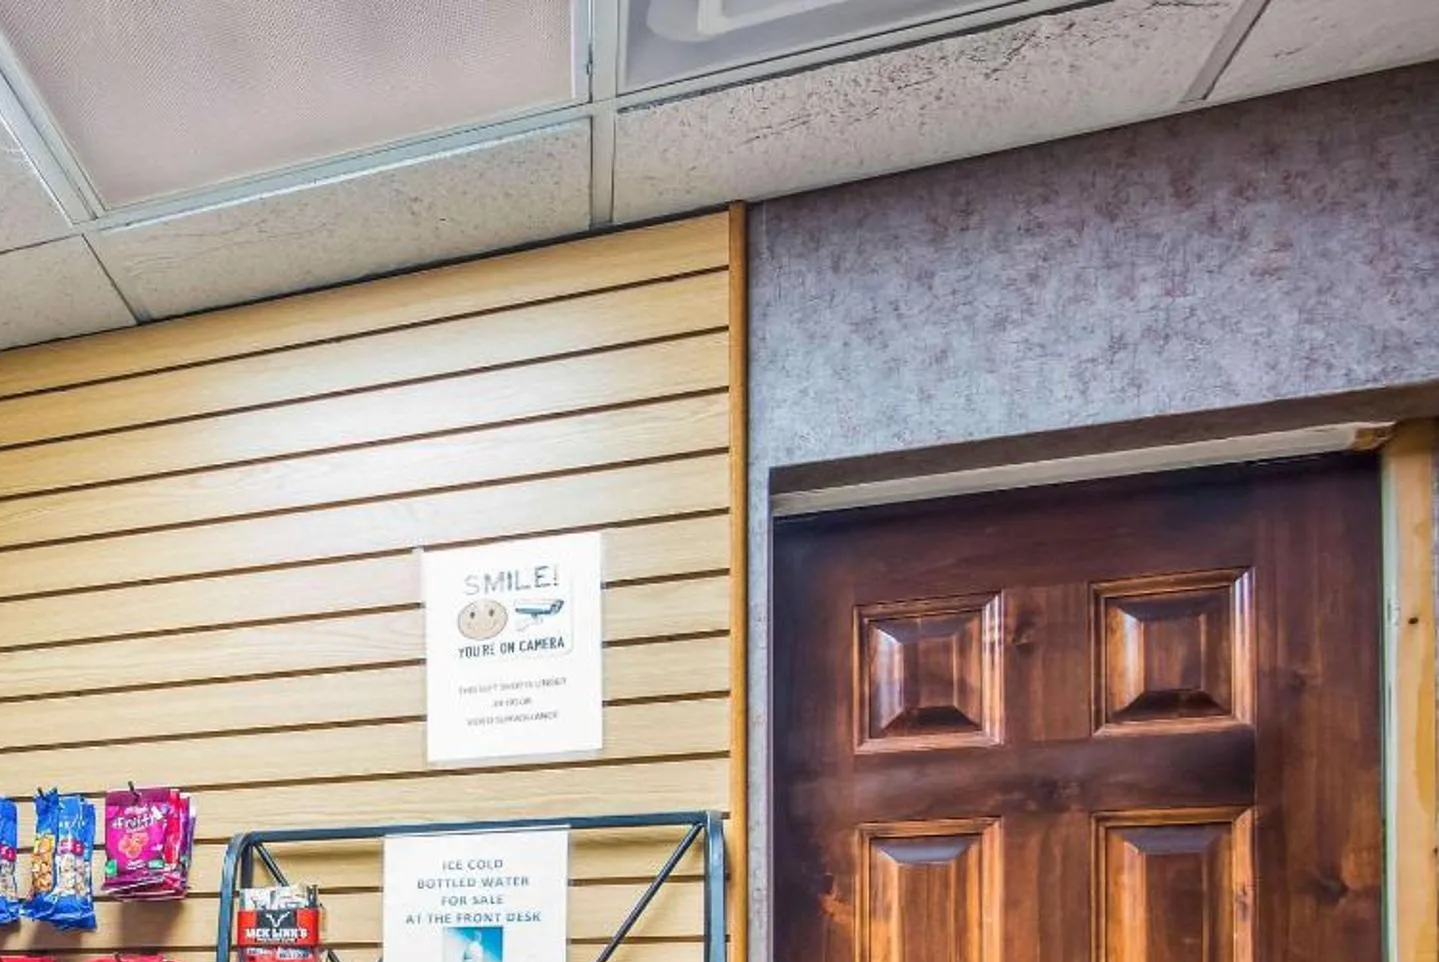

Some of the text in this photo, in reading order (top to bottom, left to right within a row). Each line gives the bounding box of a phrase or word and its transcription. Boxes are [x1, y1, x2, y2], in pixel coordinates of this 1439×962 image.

[463, 565, 559, 595] SMILE!
[499, 642, 515, 655] ON
[519, 636, 565, 652] CAMERA
[442, 859, 503, 870] ICE COLD
[417, 876, 529, 889] BOTTLED WATER
[441, 895, 504, 906] FOR SALE
[405, 911, 541, 925] AT THE FRONT DESK
